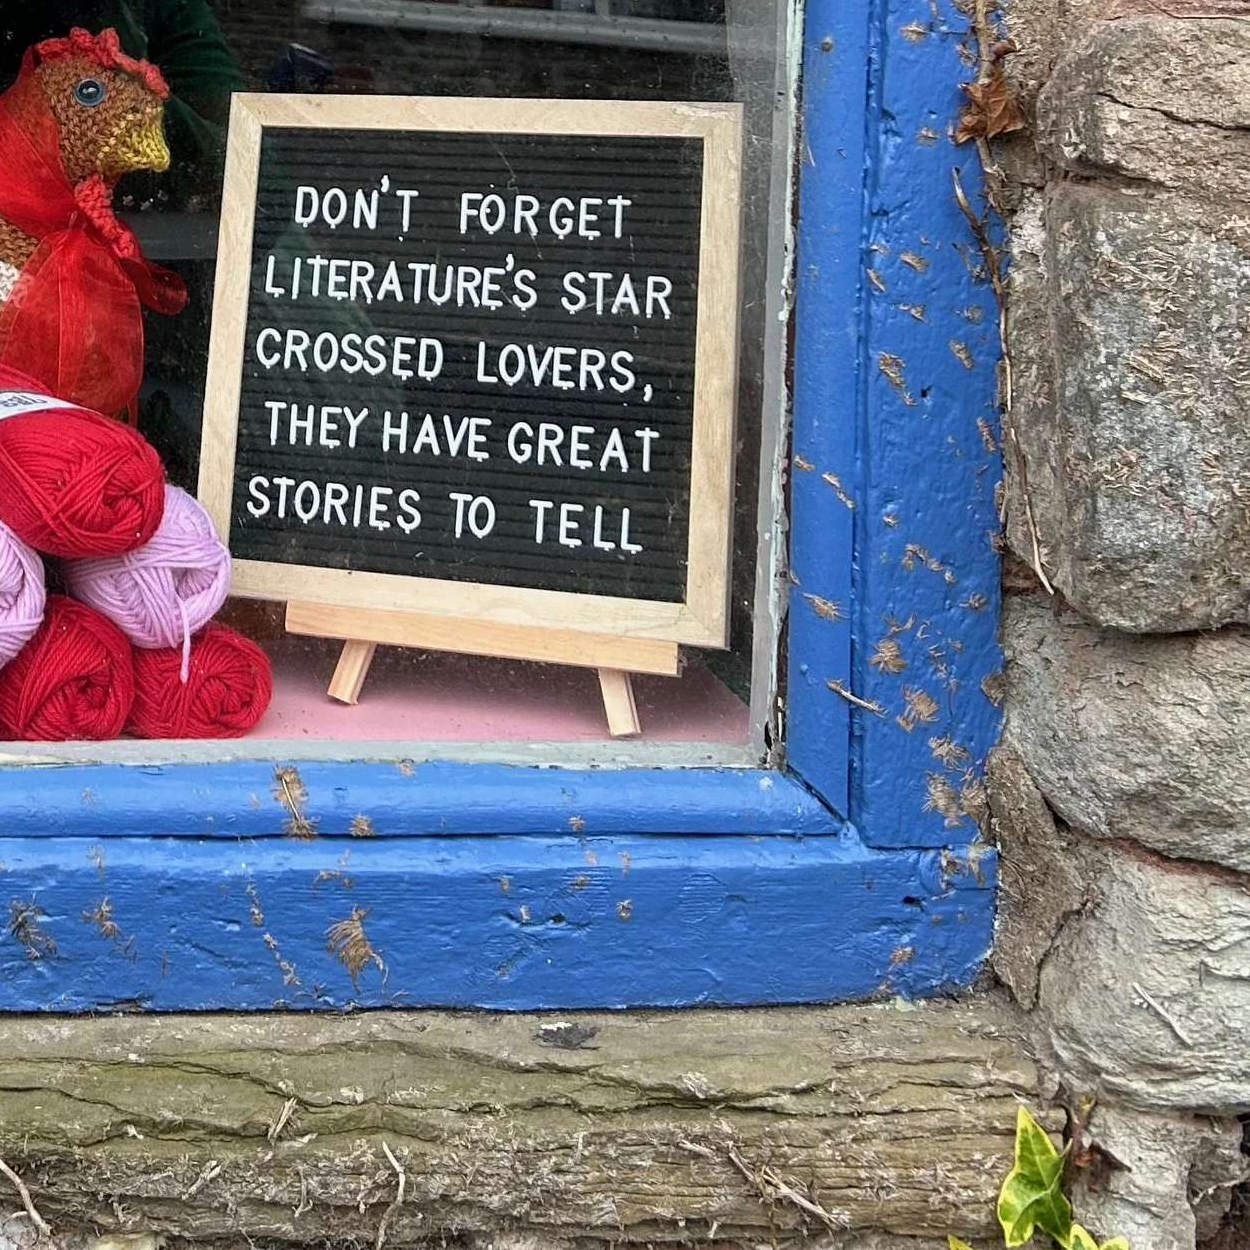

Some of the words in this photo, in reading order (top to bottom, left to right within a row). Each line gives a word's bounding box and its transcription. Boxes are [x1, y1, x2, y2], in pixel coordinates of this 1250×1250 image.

[294, 174, 419, 233] DON'T
[458, 192, 632, 240] FORGET
[264, 253, 538, 312] LITERATURE'S
[560, 271, 674, 320] STAR
[255, 327, 444, 381] CROSSED
[476, 340, 653, 403] LOVERS,
[264, 400, 369, 449] THEY
[382, 410, 493, 462] HAVE
[506, 421, 660, 473] GREAT
[246, 475, 422, 534] STORIES
[449, 491, 496, 539] TO
[529, 499, 644, 554] TELL
